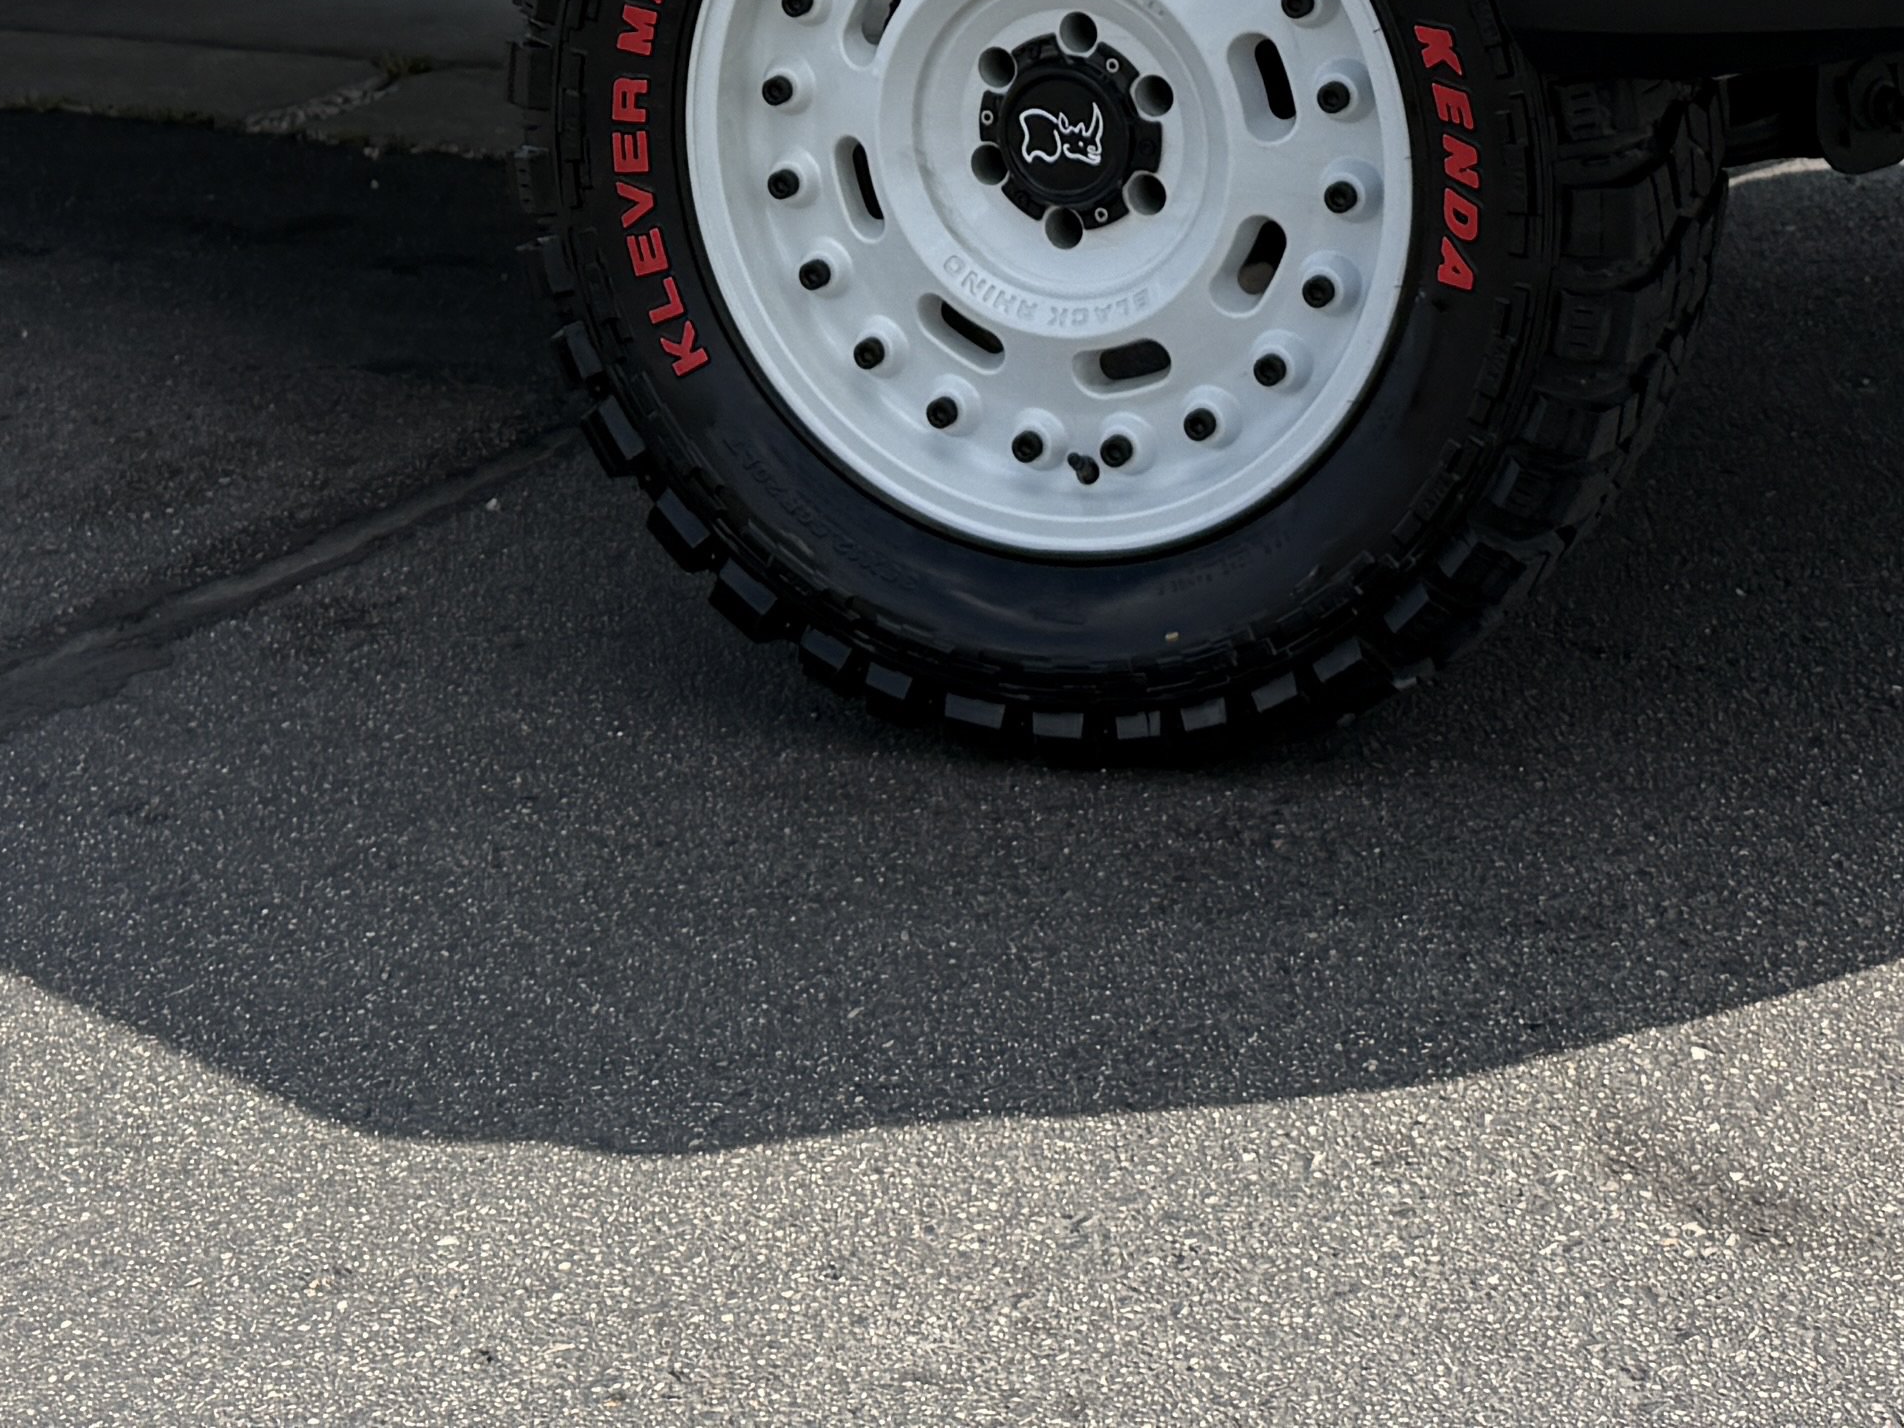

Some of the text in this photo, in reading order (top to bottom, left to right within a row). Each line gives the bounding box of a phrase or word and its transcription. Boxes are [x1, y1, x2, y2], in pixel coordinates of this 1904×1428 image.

[611, 77, 709, 378] KLEVER
[942, 252, 1153, 329] BLACK RHINO
[1413, 21, 1481, 292] KENDA
